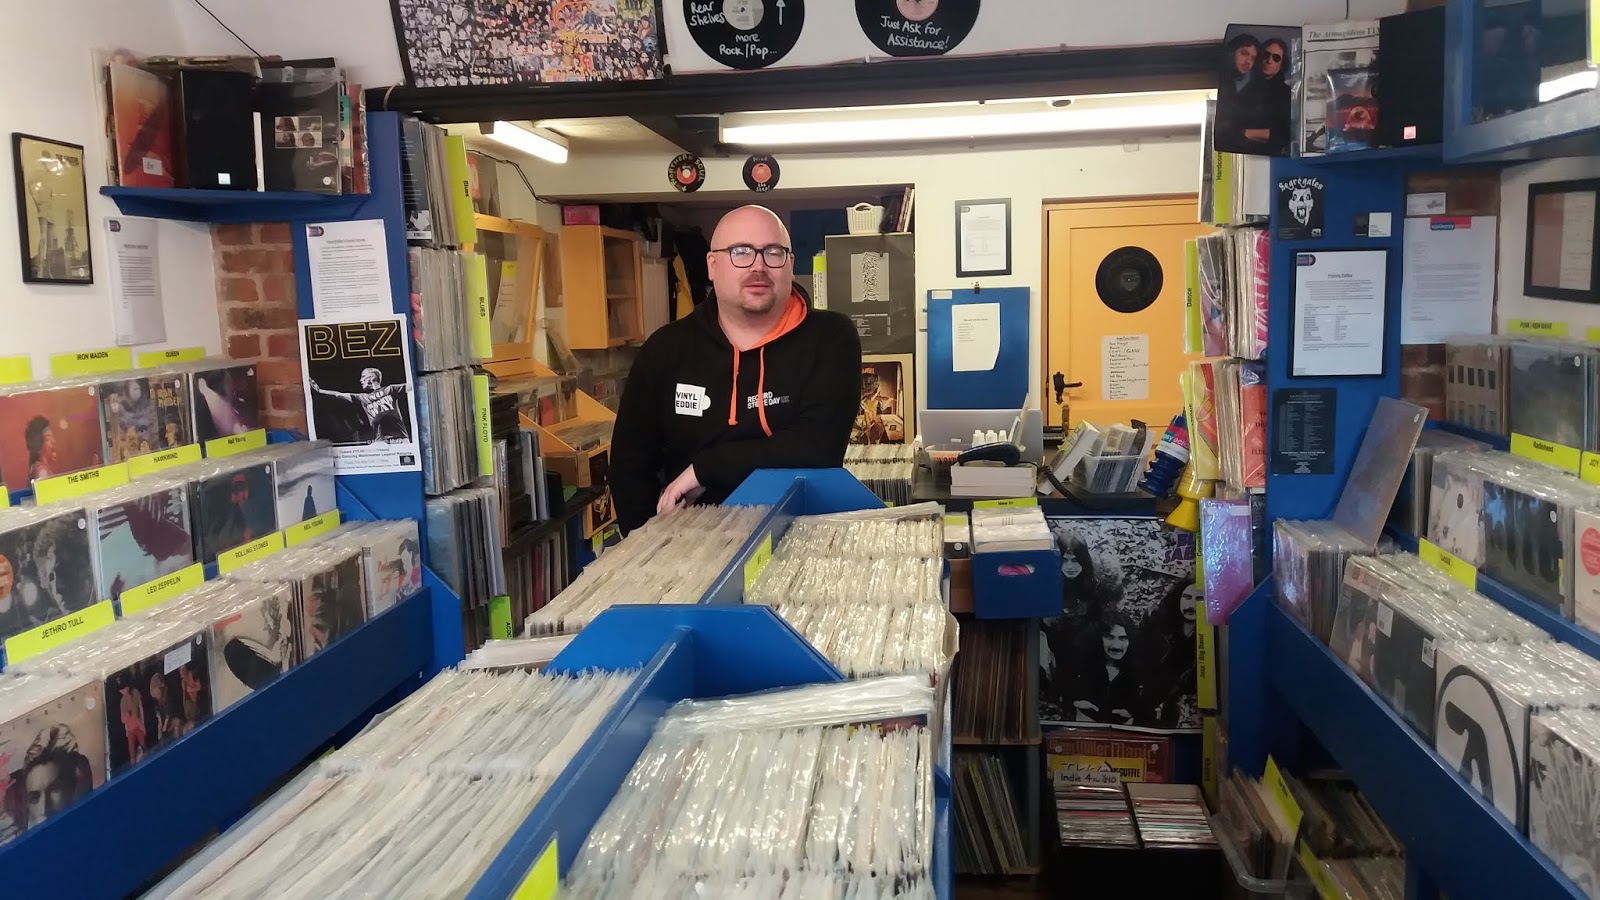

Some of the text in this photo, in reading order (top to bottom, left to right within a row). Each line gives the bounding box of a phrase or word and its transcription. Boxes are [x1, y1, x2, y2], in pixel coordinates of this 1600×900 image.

[690, 0, 714, 14] Rear
[689, 12, 726, 27] Shelves
[880, 15, 942, 37] Just Ask for
[735, 32, 760, 44] more
[1309, 31, 1322, 39] The
[887, 35, 950, 51] Assistance!
[694, 159, 705, 182] SOUL
[1278, 177, 1324, 192] Segregates
[307, 320, 401, 361] BEZ
[77, 351, 109, 360] IRON MAIDEN
[165, 350, 180, 358] QUEEN
[676, 391, 698, 401] VINYL
[747, 391, 773, 403] RECRD
[747, 398, 769, 409] STOE
[769, 396, 781, 406] DAY
[675, 401, 698, 410] EDDIE
[153, 452, 178, 463] HAWKWIND
[67, 470, 100, 484] THE SMITHS
[311, 518, 324, 529] YOUNG
[234, 540, 269, 559] ROLLING STONES
[146, 575, 181, 595] LED ZEPPELIN
[41, 616, 84, 640] JETHRO TULL
[1060, 772, 1082, 782] Indie
[1084, 773, 1093, 783] 4
